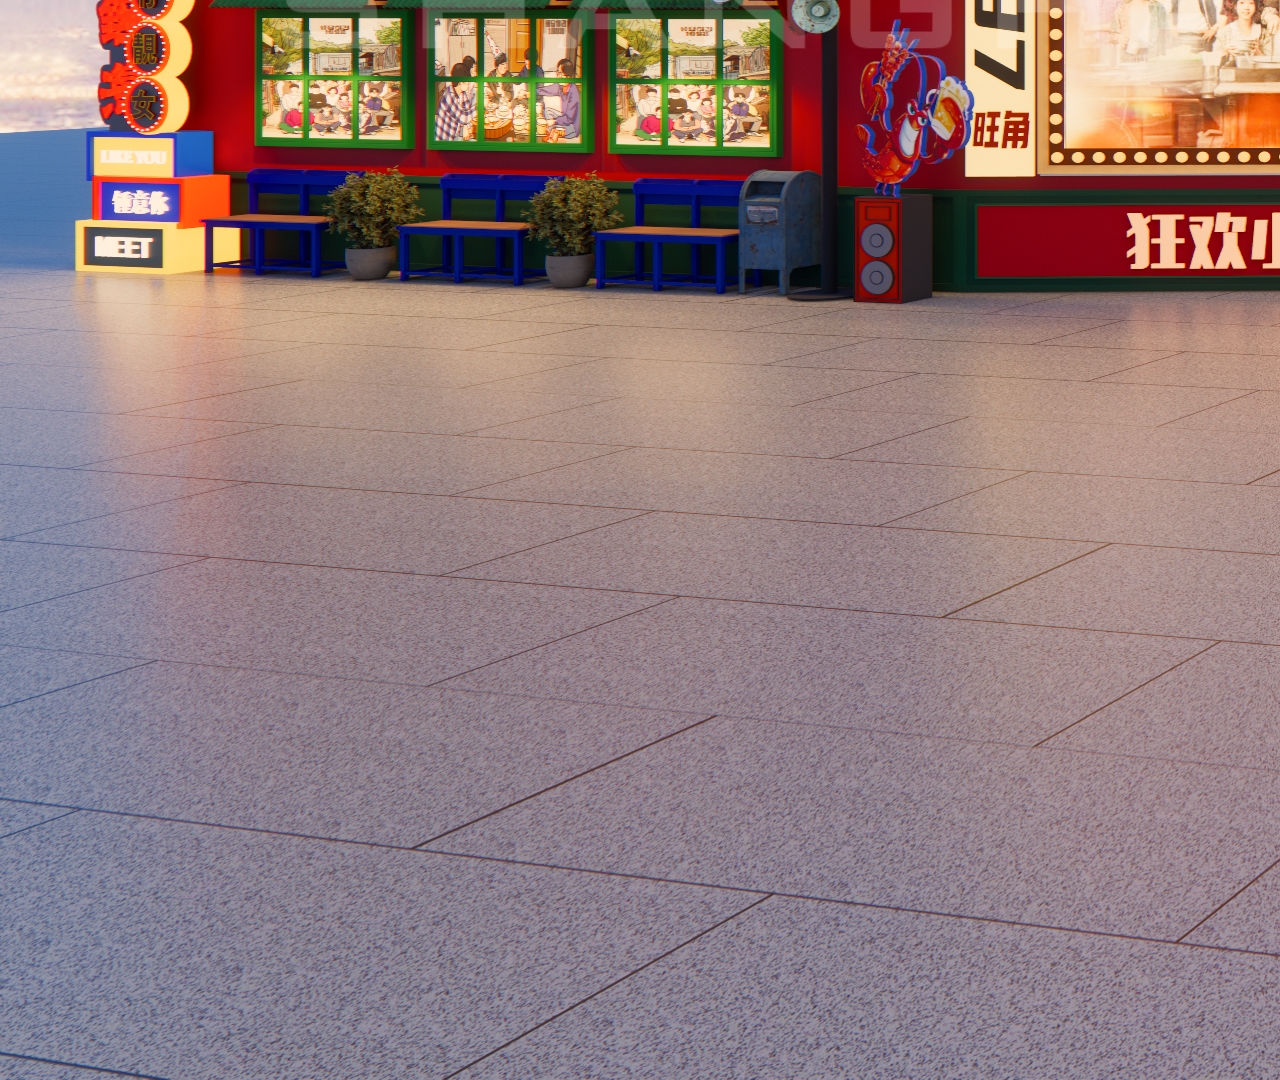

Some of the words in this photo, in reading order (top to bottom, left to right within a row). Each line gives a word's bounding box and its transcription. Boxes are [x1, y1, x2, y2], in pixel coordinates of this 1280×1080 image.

[973, 111, 1030, 149] 旺角
[100, 150, 134, 164] LIKE
[134, 151, 167, 165] YOU
[95, 236, 154, 259] MEET
